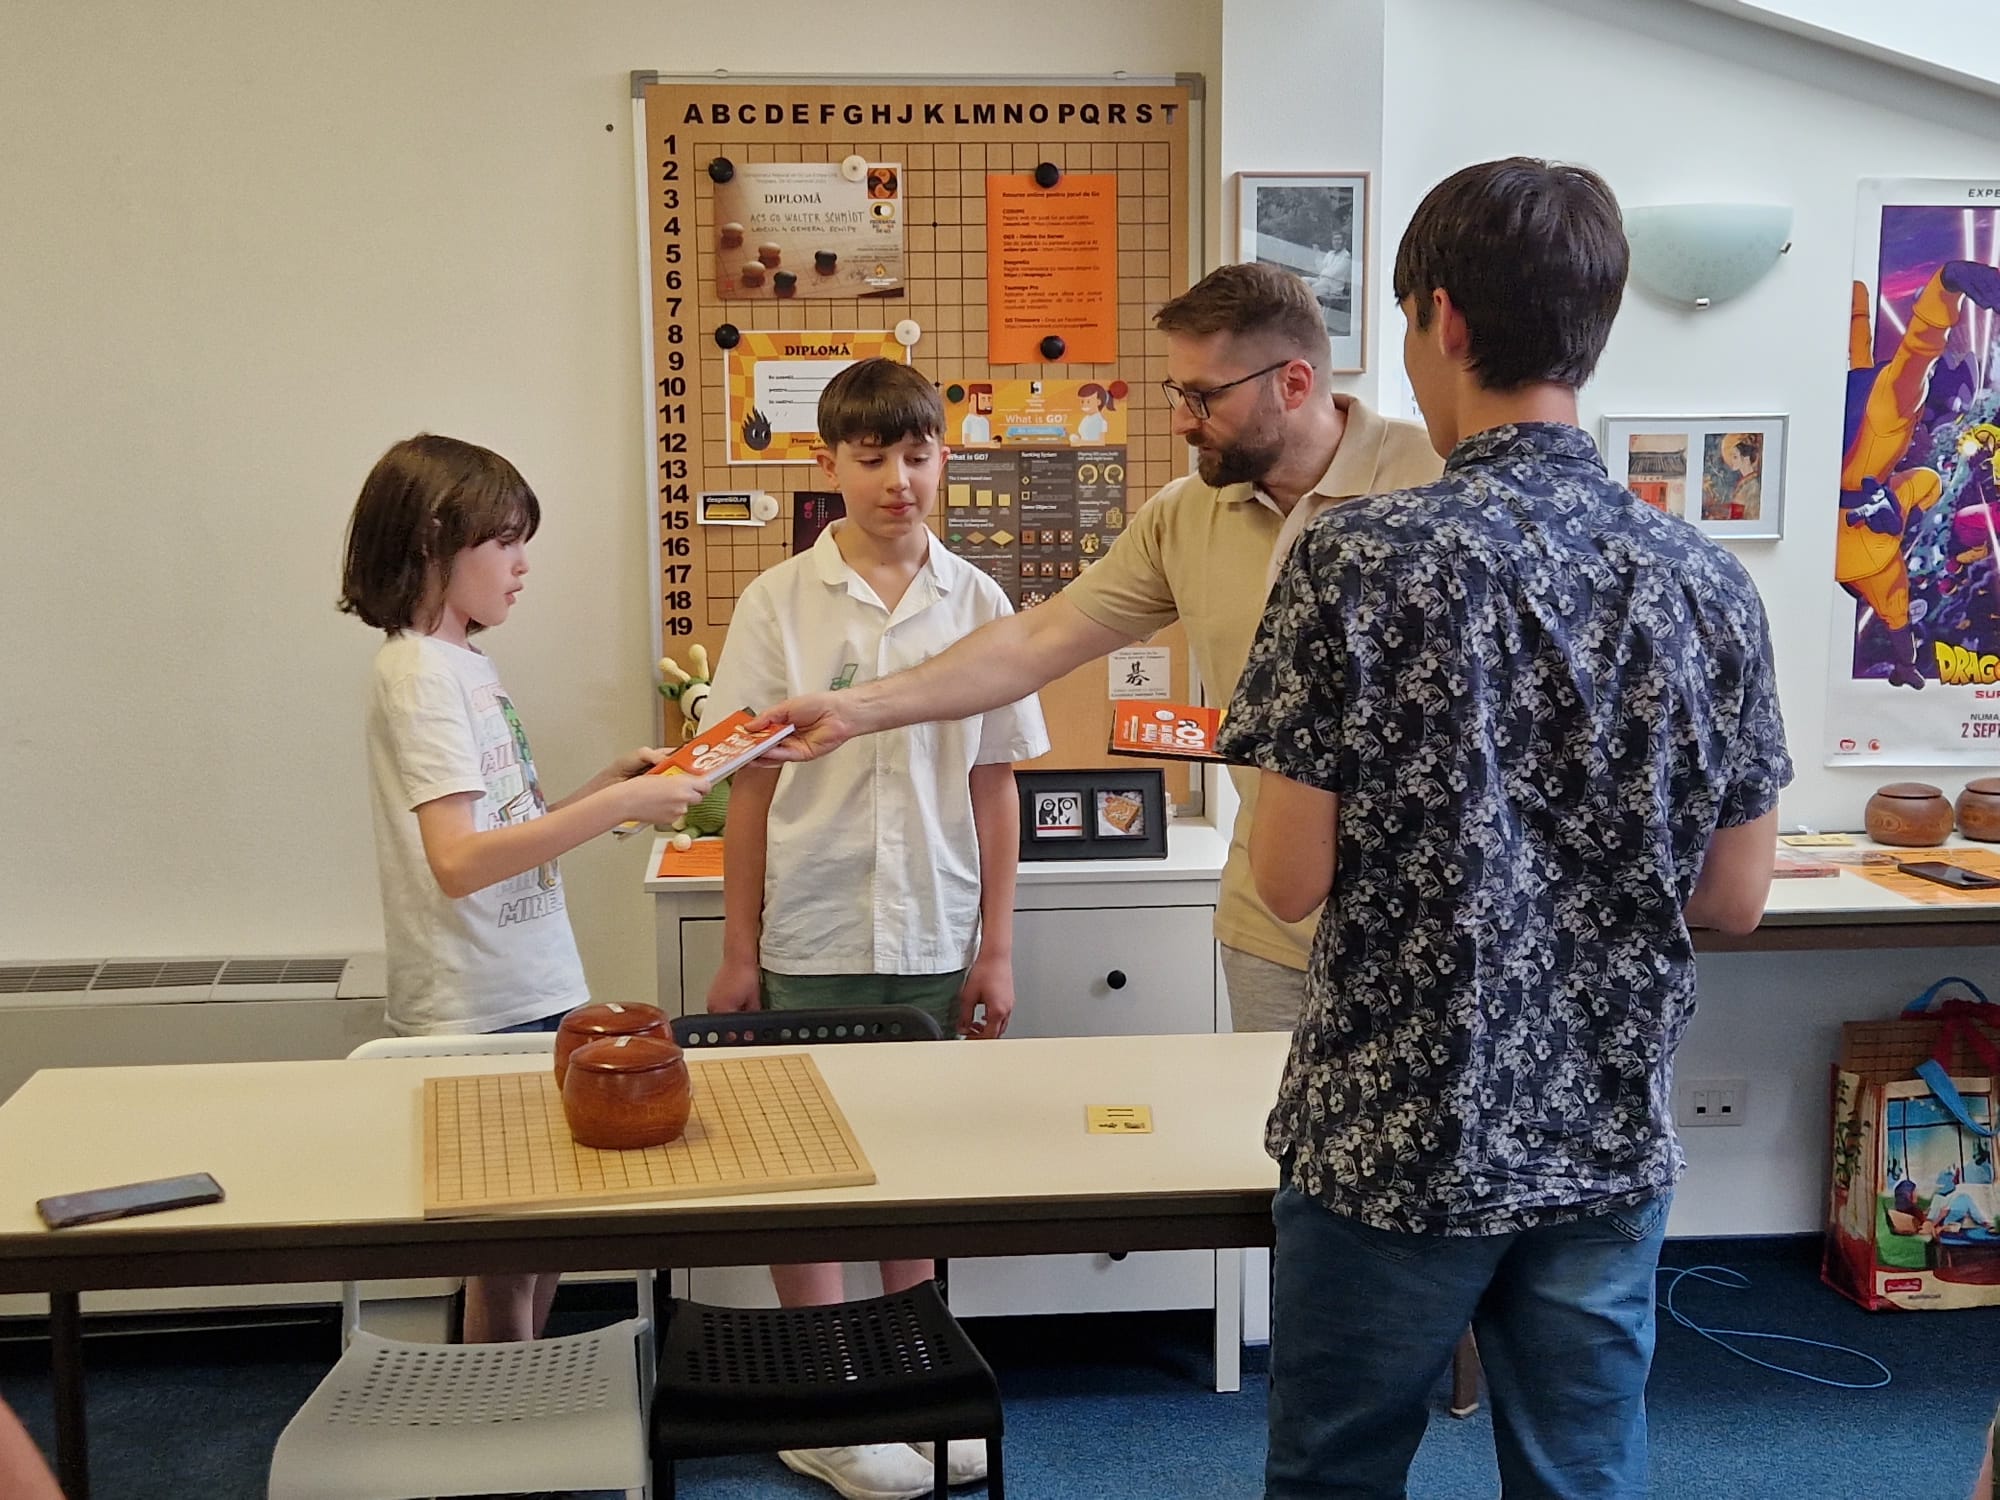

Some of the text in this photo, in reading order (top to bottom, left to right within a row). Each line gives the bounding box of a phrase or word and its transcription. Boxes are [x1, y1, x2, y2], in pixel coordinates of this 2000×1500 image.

[663, 134, 676, 155] 1
[662, 160, 679, 181] 2
[663, 188, 680, 210] 3
[663, 216, 681, 237] 4
[665, 243, 682, 264] 5
[665, 270, 682, 290] 6
[665, 297, 683, 318] 7
[667, 324, 684, 345] 8
[785, 342, 851, 356] DIPLOMĂ
[668, 351, 685, 371] 9
[658, 376, 686, 398] 10
[659, 403, 685, 424] 11
[1006, 414, 1068, 424] What is GO?
[659, 432, 687, 453] 12
[659, 459, 688, 480] 13
[660, 483, 690, 504] 14
[661, 510, 689, 530] 15
[662, 536, 690, 557] 16
[664, 564, 692, 585] 17
[664, 590, 692, 611] 18
[665, 616, 693, 636] 19
[1934, 641, 2000, 686] DRAG
[1961, 722, 1970, 738] 2
